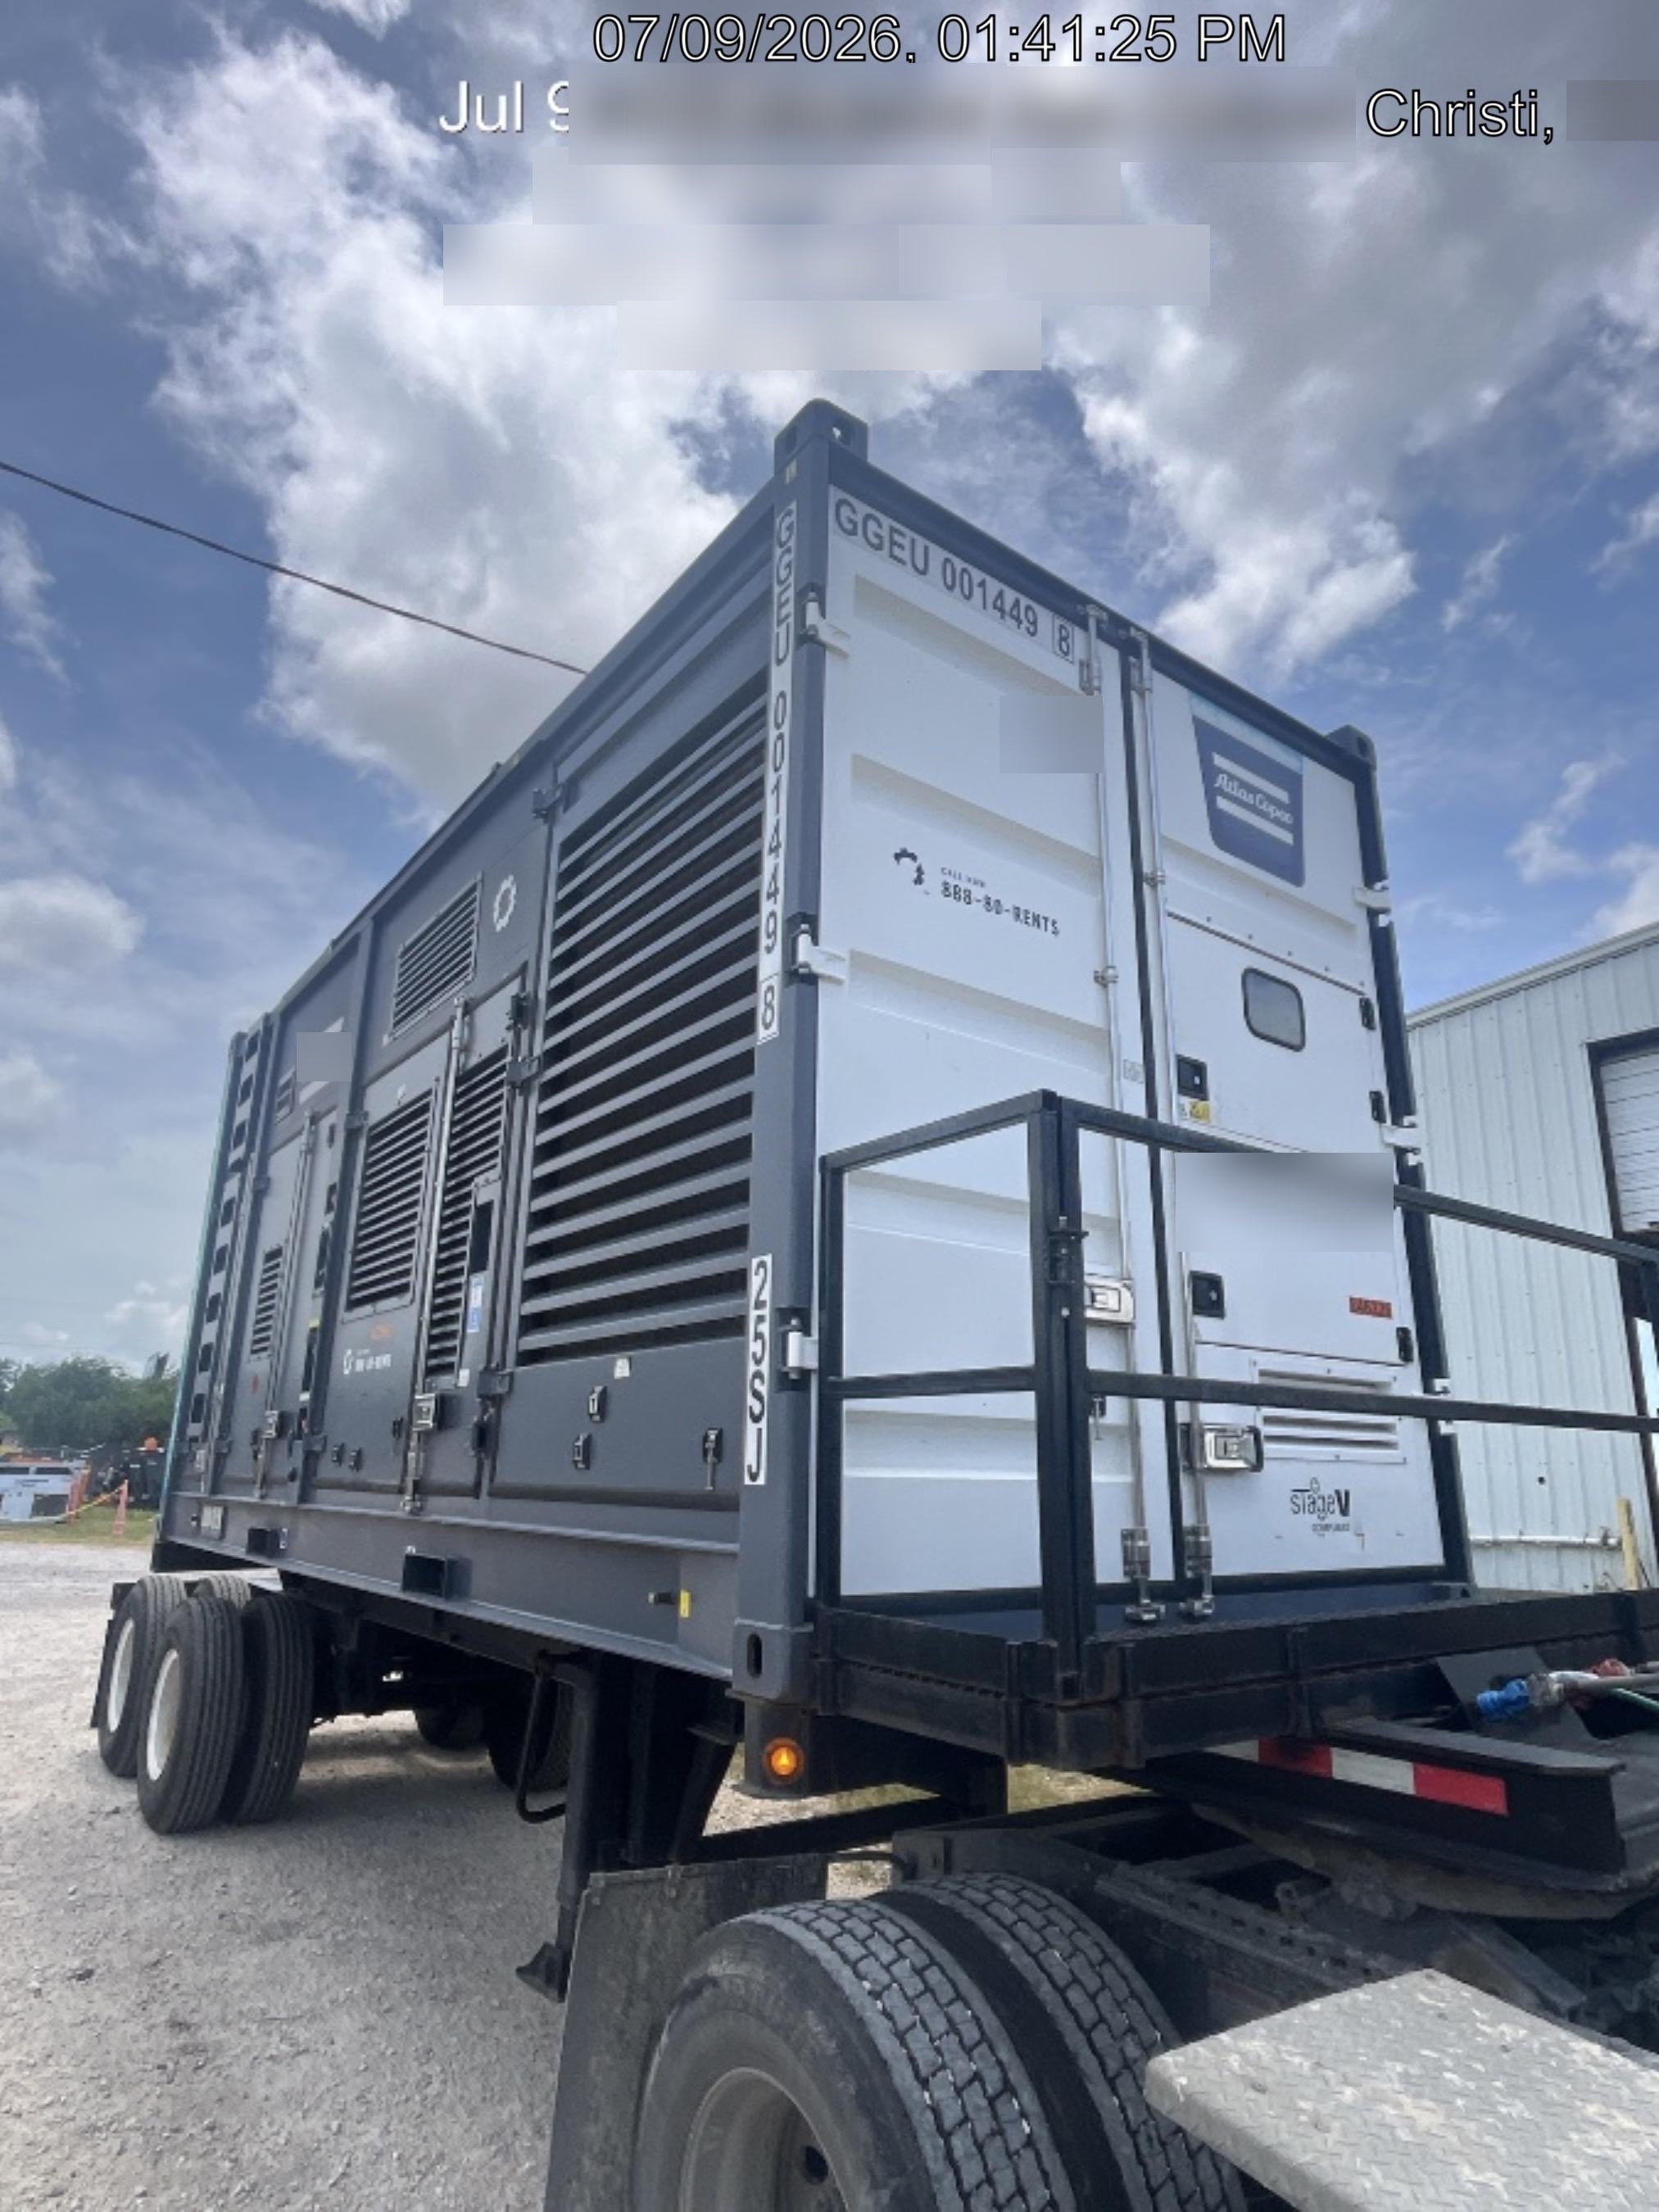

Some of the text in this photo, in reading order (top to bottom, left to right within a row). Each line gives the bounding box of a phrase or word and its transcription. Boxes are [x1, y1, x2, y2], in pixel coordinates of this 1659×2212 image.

[834, 497, 930, 576] GGEU
[941, 557, 1038, 637] 001449
[761, 506, 793, 1031] GGEU 001449 8
[746, 1259, 768, 1483] 25SJ
